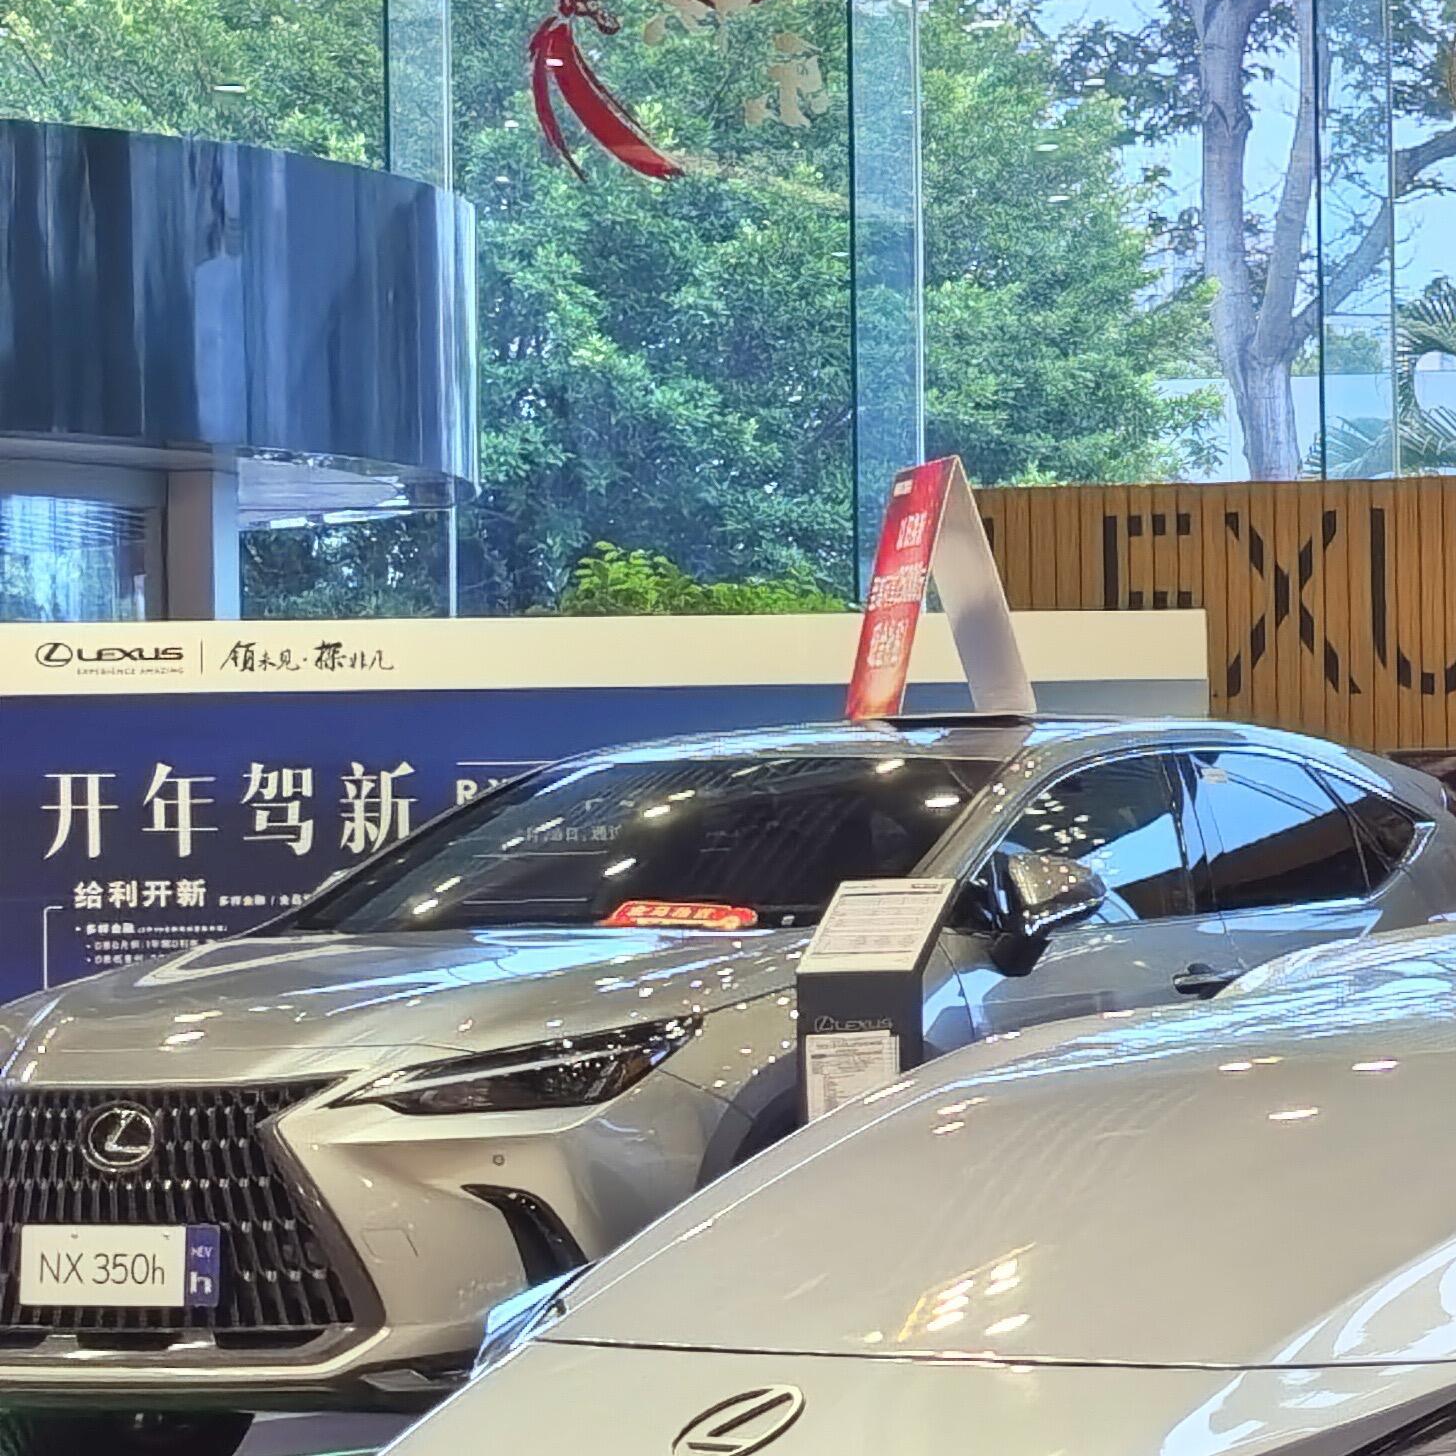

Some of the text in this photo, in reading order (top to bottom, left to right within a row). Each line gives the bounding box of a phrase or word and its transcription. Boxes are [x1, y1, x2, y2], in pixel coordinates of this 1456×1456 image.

[77, 647, 184, 662] LEXUS
[41, 762, 418, 860] 开年驾新
[74, 879, 207, 909] 给利开新
[836, 1016, 893, 1032] LEXUS
[40, 1251, 165, 1286] NX 350h
[189, 1271, 212, 1294] h
